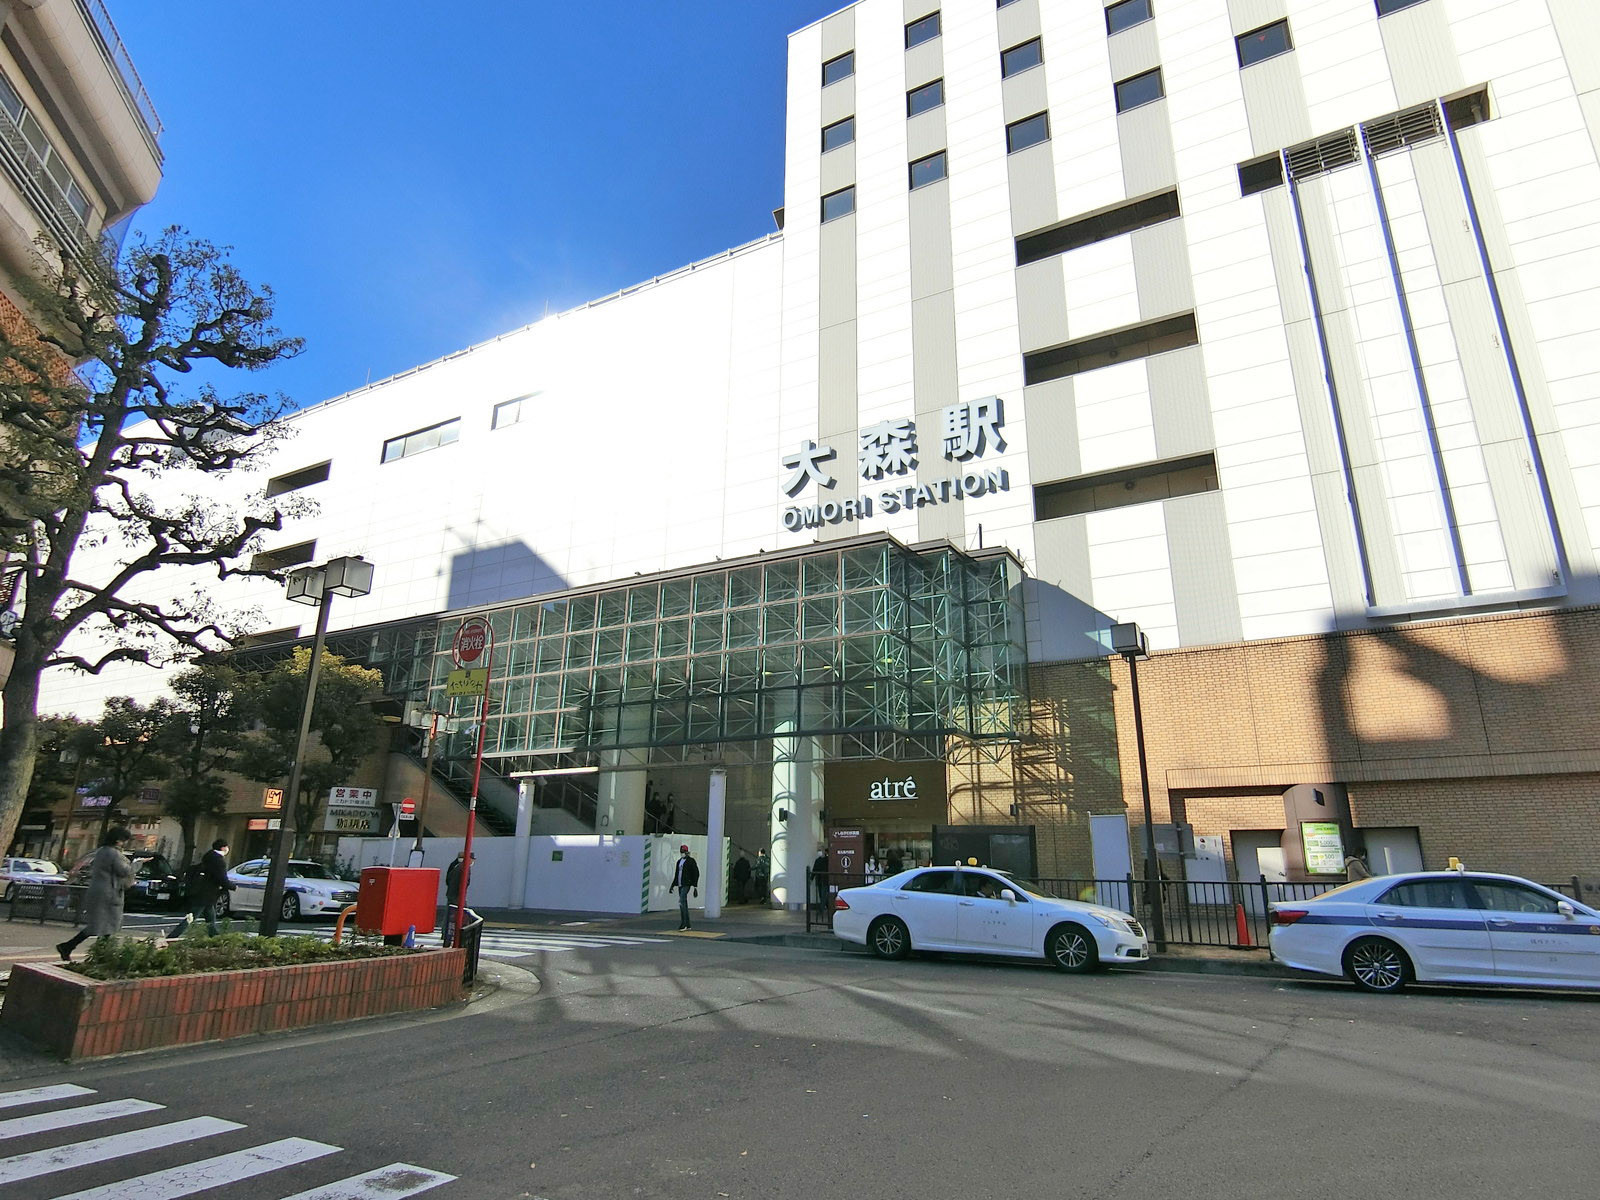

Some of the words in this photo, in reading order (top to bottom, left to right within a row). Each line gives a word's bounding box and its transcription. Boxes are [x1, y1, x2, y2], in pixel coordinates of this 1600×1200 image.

[782, 395, 1007, 498] 大森駅
[878, 467, 1010, 514] STATION
[460, 635, 483, 650] 消火栓
[336, 788, 372, 799] 営業中
[870, 776, 917, 799] atré
